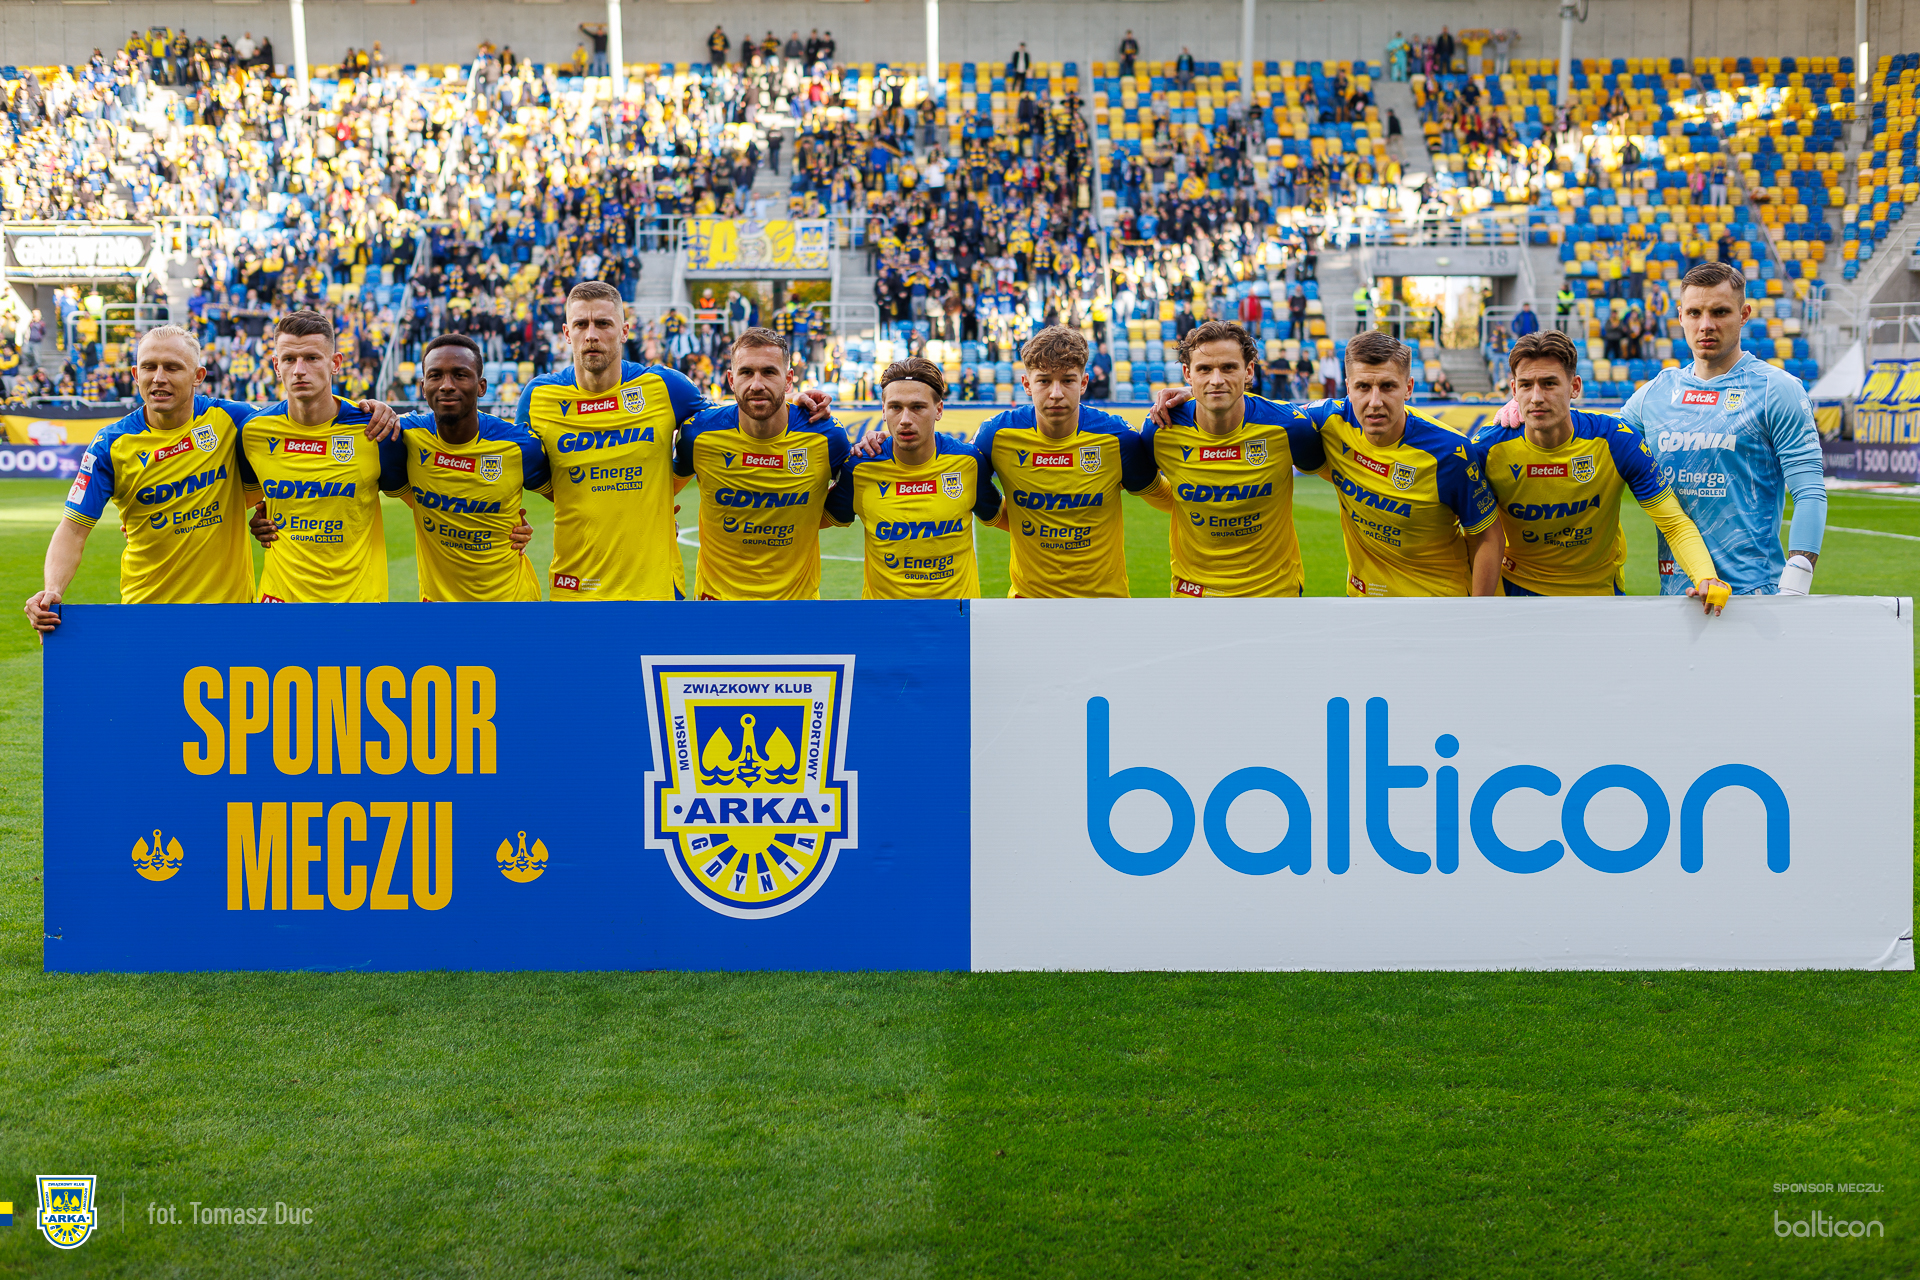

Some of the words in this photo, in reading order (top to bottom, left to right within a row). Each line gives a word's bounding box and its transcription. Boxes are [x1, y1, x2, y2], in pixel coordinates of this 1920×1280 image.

[580, 400, 615, 412] Betclic
[1685, 392, 1716, 403] Betclic
[287, 441, 323, 453] Betclic
[557, 427, 655, 454] GDYNIA
[1658, 431, 1737, 452] GDYNIA
[158, 441, 190, 460] Betclic
[1203, 448, 1238, 459] Betclic
[437, 455, 472, 470] Betclic
[746, 455, 780, 467] Betclic
[1035, 455, 1070, 465] Betclic
[1356, 454, 1387, 474] Betclic
[1890, 449, 1918, 474] 000
[590, 466, 643, 482] Energa
[1531, 466, 1565, 476] Betclic
[1678, 469, 1725, 487] Energa
[136, 464, 227, 505] GDYNIA
[263, 479, 356, 500] GDYNIA
[591, 483, 617, 493] GRUPA
[617, 482, 642, 491] ORLEN
[899, 482, 934, 494] Betclic
[1177, 482, 1272, 502] GDYNIA
[1678, 488, 1698, 496] GRUPA
[412, 486, 501, 513] GDYNIA
[715, 488, 810, 509] GDYNIA
[1013, 489, 1103, 510] GDYNIA
[1331, 469, 1412, 518] GDYNIA
[173, 501, 219, 525] Energa
[1507, 494, 1600, 521] GDYNIA
[198, 516, 222, 528] ORLEN
[290, 516, 343, 534] Energa
[1209, 512, 1260, 529] Energa
[1351, 510, 1401, 537] Energa
[439, 524, 492, 543] Energa
[743, 521, 795, 538] Energa
[875, 518, 963, 541] GDYNIA
[1040, 524, 1091, 541] Energa
[1236, 525, 1262, 536] ORLEN
[290, 534, 314, 542] GRUPA
[316, 535, 343, 543] ORLEN
[440, 540, 463, 550] GRUPA
[768, 537, 793, 547] ORLEN
[1065, 540, 1091, 549] ORLEN
[904, 554, 954, 571] Energa
[556, 576, 577, 588] APS
[930, 570, 954, 580] ORLEN
[1179, 581, 1201, 595] APS
[683, 683, 770, 697] ZWIĄZKOWY
[774, 683, 813, 694] KLUB
[183, 665, 497, 775] SPONSOR
[674, 715, 690, 771] MORSKI
[807, 700, 824, 781] SPORTOWY
[1086, 696, 1790, 876] balticon
[683, 797, 819, 824] ARKA
[227, 801, 453, 911] MECZU
[691, 836, 817, 893] GDYNIA
